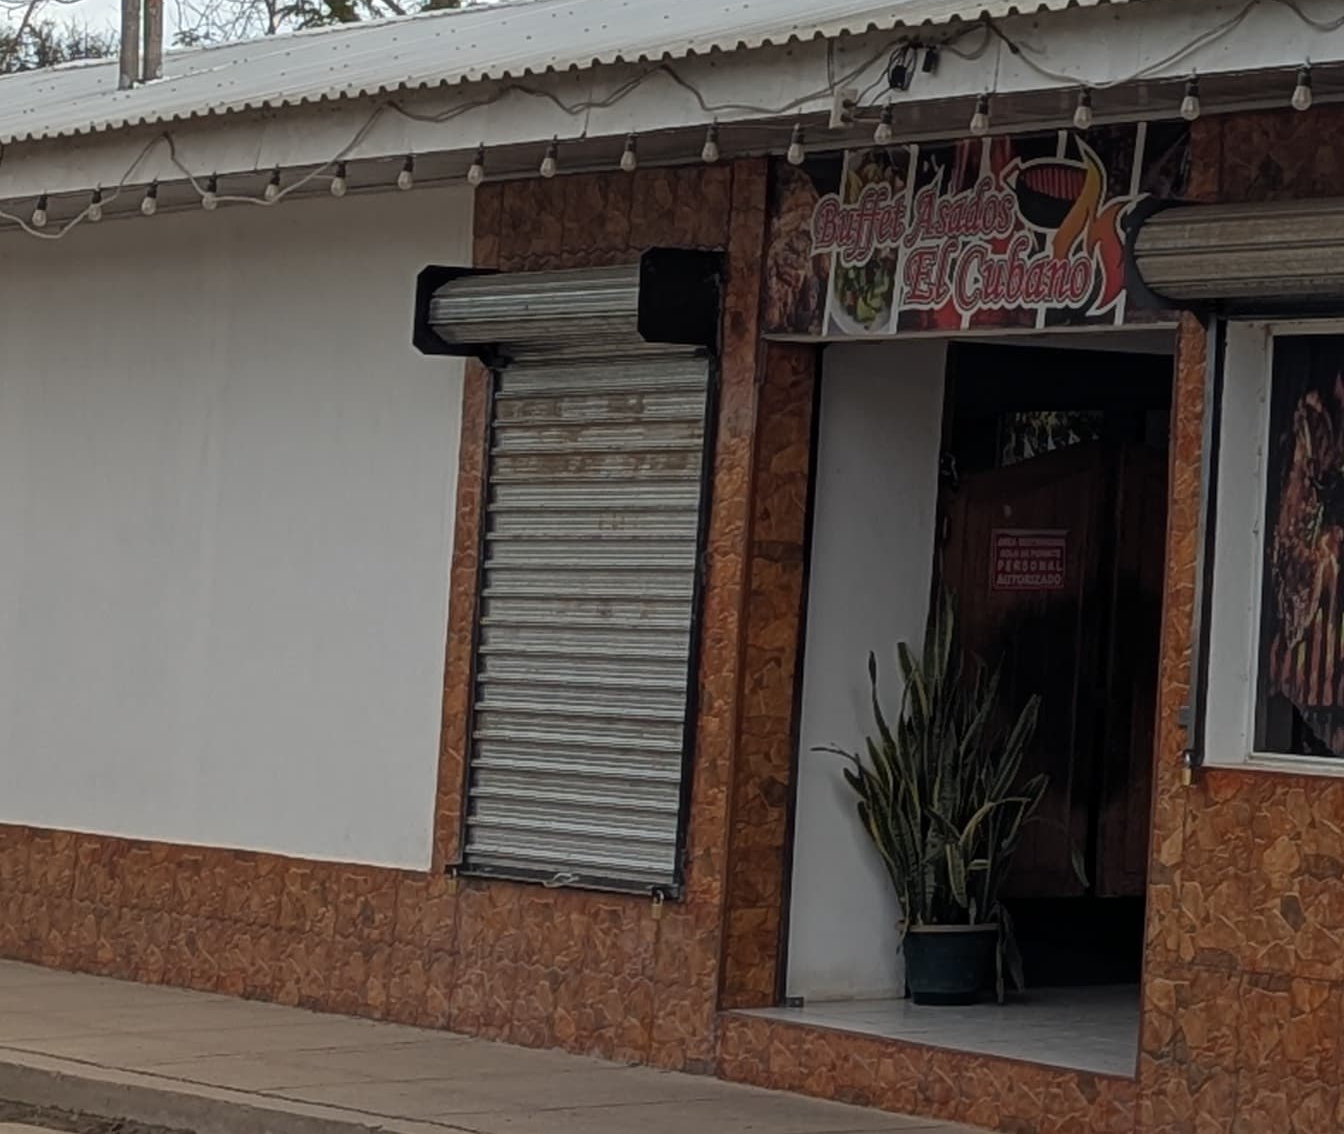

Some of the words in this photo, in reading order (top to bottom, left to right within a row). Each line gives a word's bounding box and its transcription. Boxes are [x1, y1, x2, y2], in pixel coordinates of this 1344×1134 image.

[817, 185, 909, 260] Buffet
[904, 179, 1014, 246] Asados
[903, 239, 960, 306] El
[955, 237, 1095, 310] Cubano
[997, 560, 1063, 572] PERSONAL
